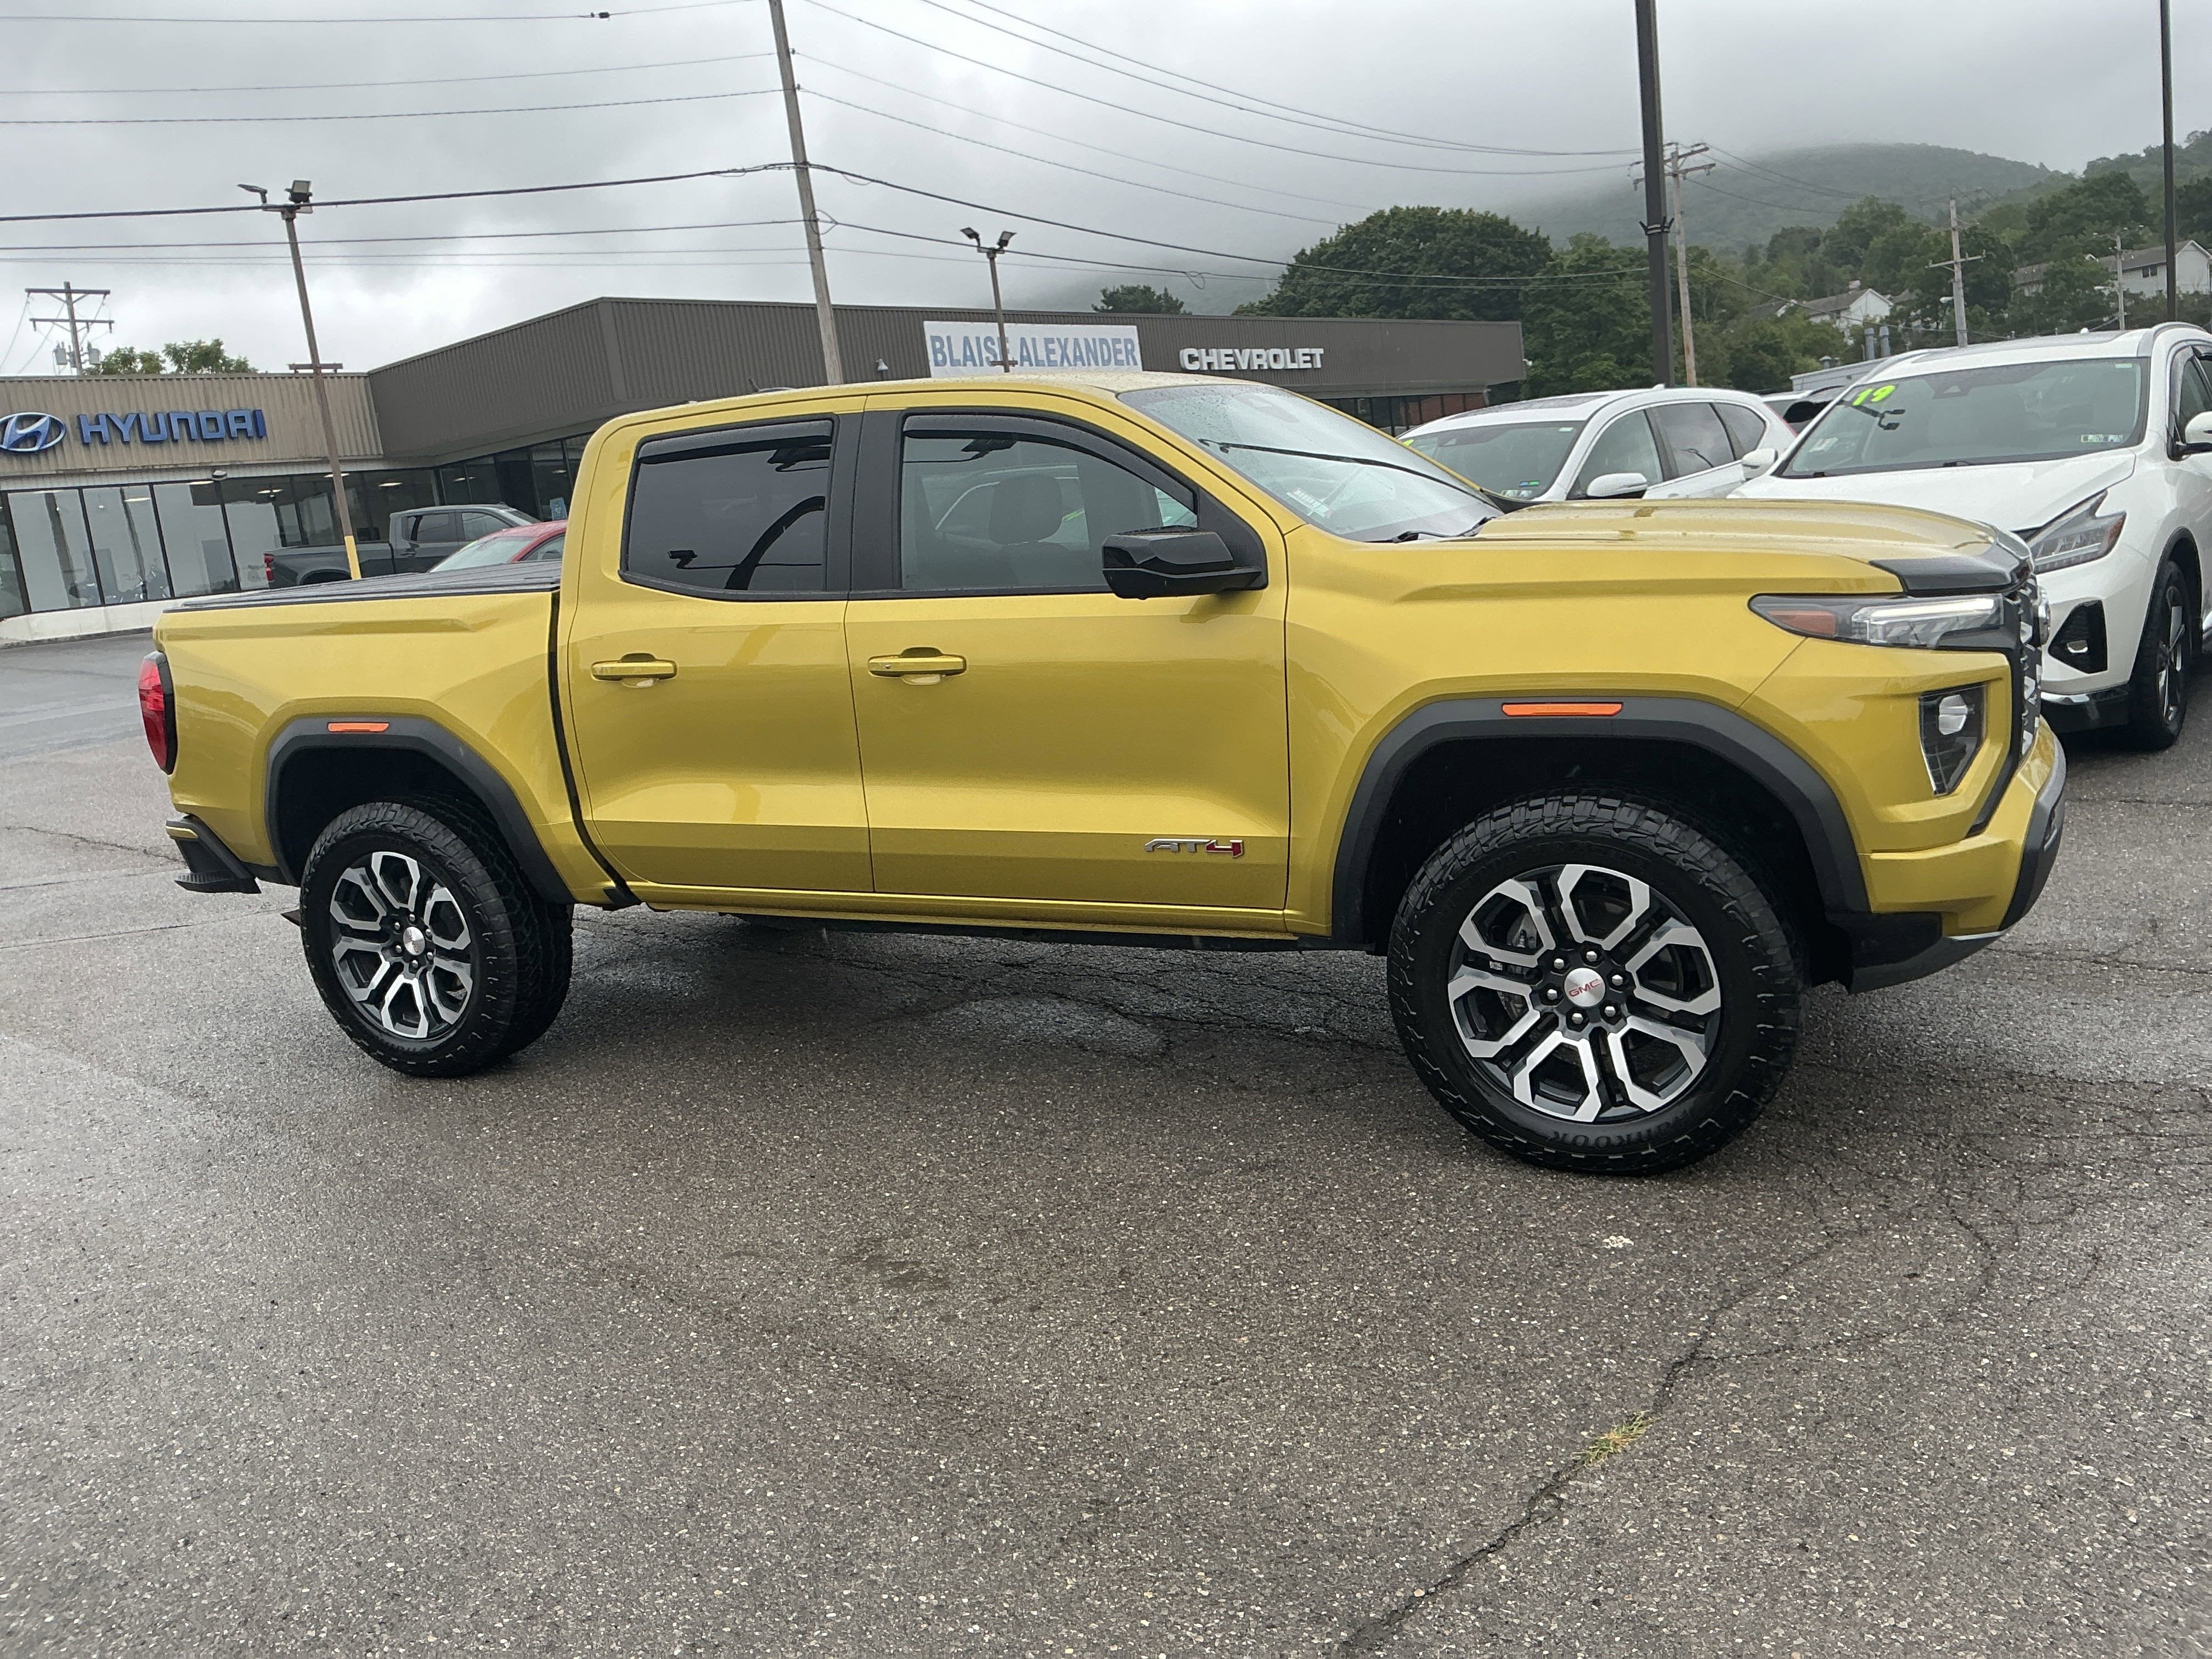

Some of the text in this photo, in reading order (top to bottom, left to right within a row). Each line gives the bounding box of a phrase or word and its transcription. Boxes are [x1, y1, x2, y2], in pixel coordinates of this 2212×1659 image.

[1019, 336, 1138, 367] ALEXANDER
[1180, 348, 1324, 370] CHEVROLET
[1852, 385, 1895, 406] 19
[78, 409, 266, 444] HYUNDAI
[1144, 838, 1243, 858] AT4
[1569, 979, 1601, 997] GMC
